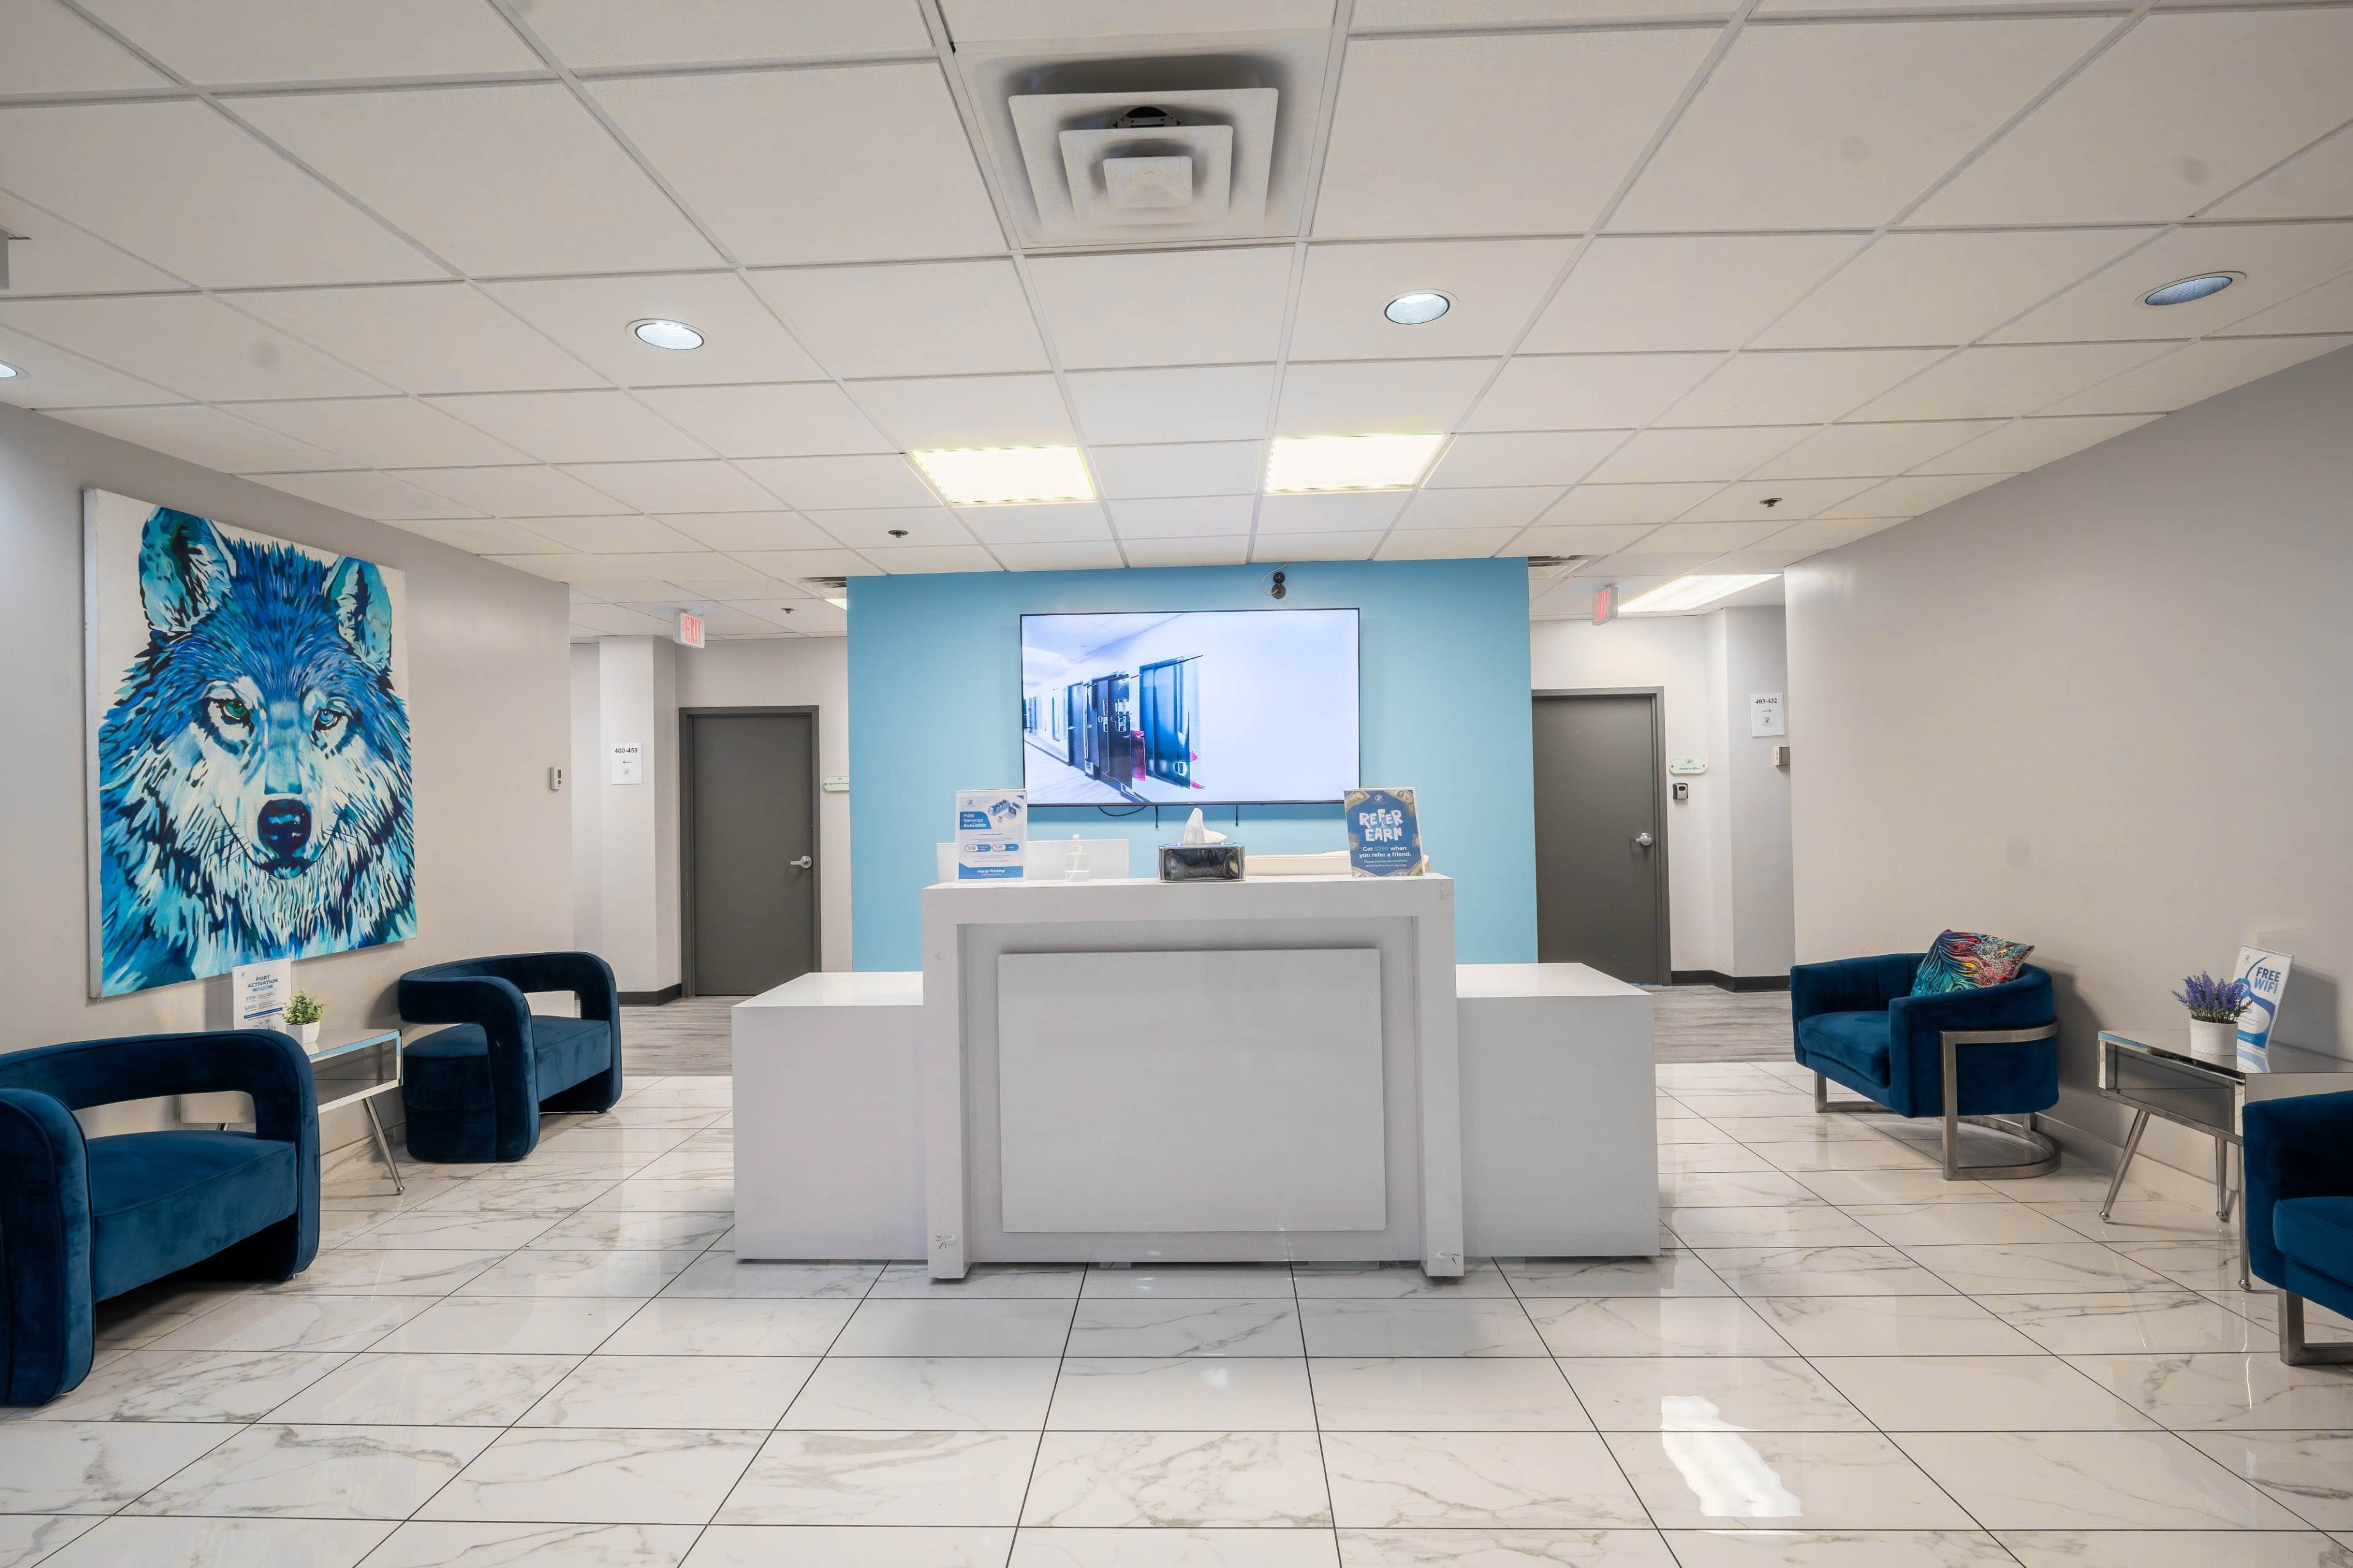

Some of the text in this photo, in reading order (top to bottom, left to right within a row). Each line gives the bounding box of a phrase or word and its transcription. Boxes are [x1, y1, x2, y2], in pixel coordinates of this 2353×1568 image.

[1594, 589, 1608, 621] EXIT
[684, 615, 702, 645] EXIT
[1359, 809, 1404, 828] REFER
[1365, 827, 1402, 842] EARN
[2256, 967, 2281, 982] FREE
[248, 979, 278, 988] ACTIVATION
[2254, 977, 2278, 994] WIFI
